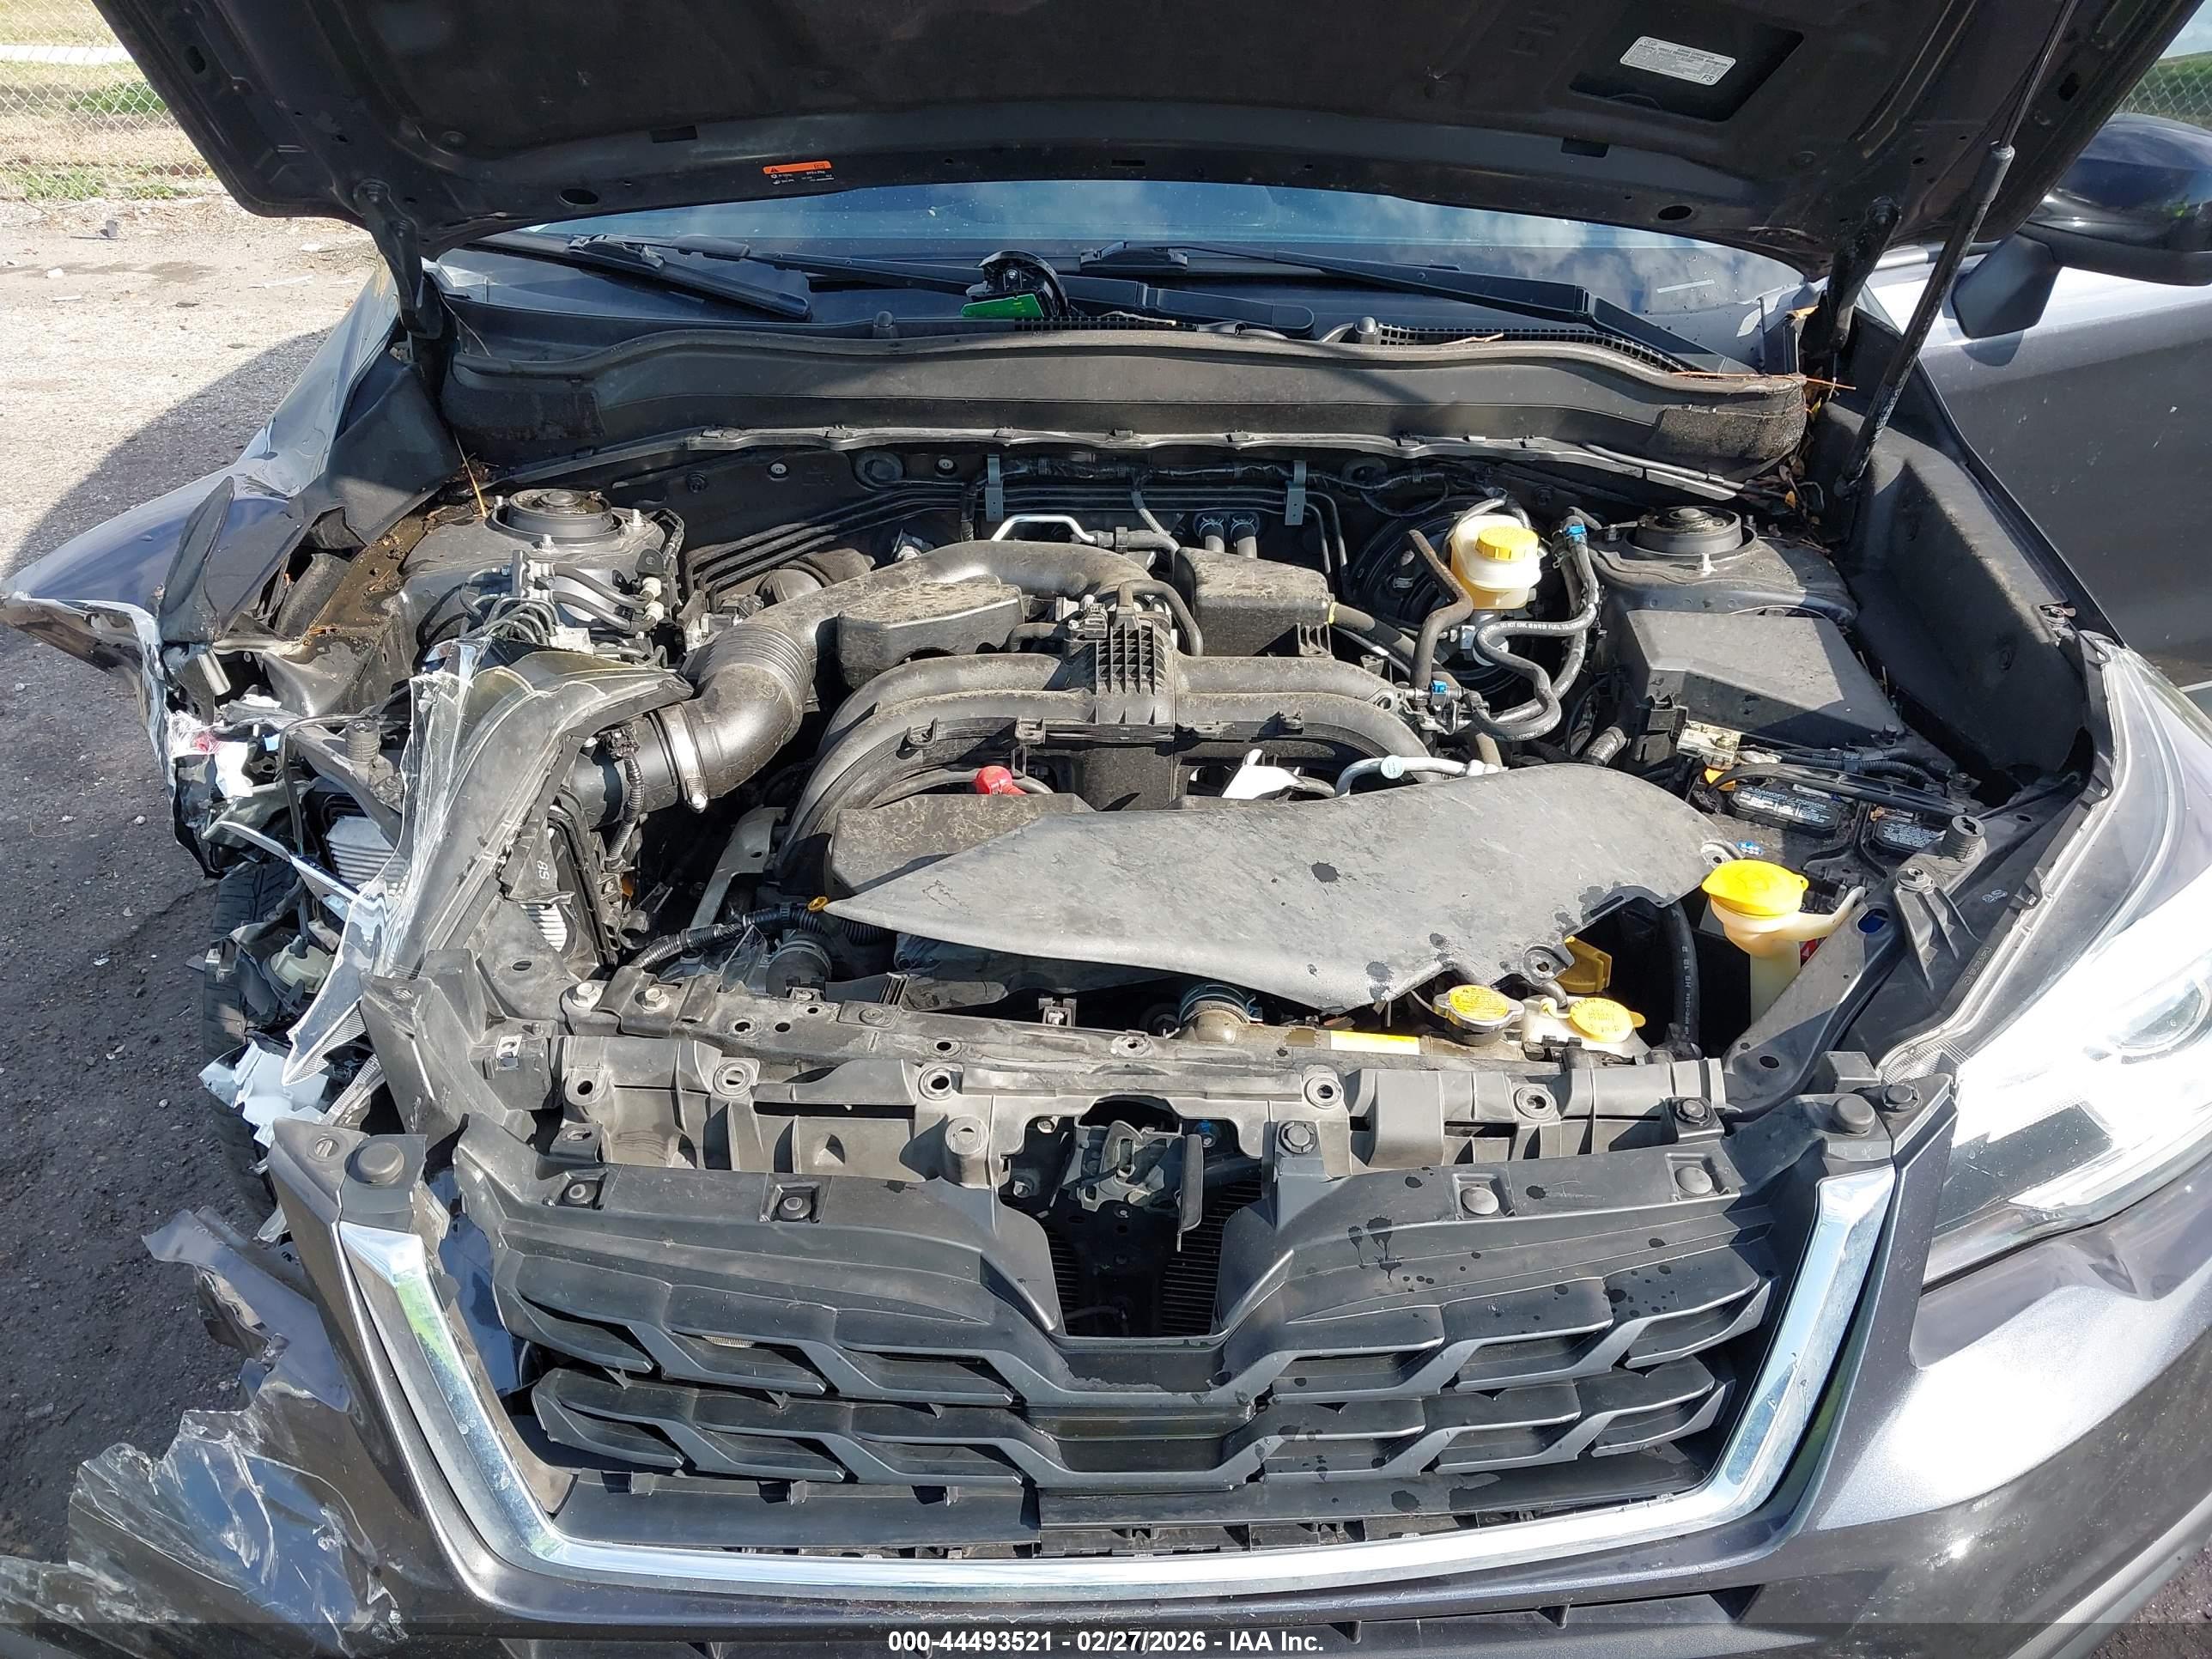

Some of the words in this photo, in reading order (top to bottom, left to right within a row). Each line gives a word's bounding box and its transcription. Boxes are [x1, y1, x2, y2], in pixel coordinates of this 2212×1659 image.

[1701, 74, 1715, 82] FS
[1753, 787, 1788, 800] DANGER
[1796, 798, 1827, 809] POISON
